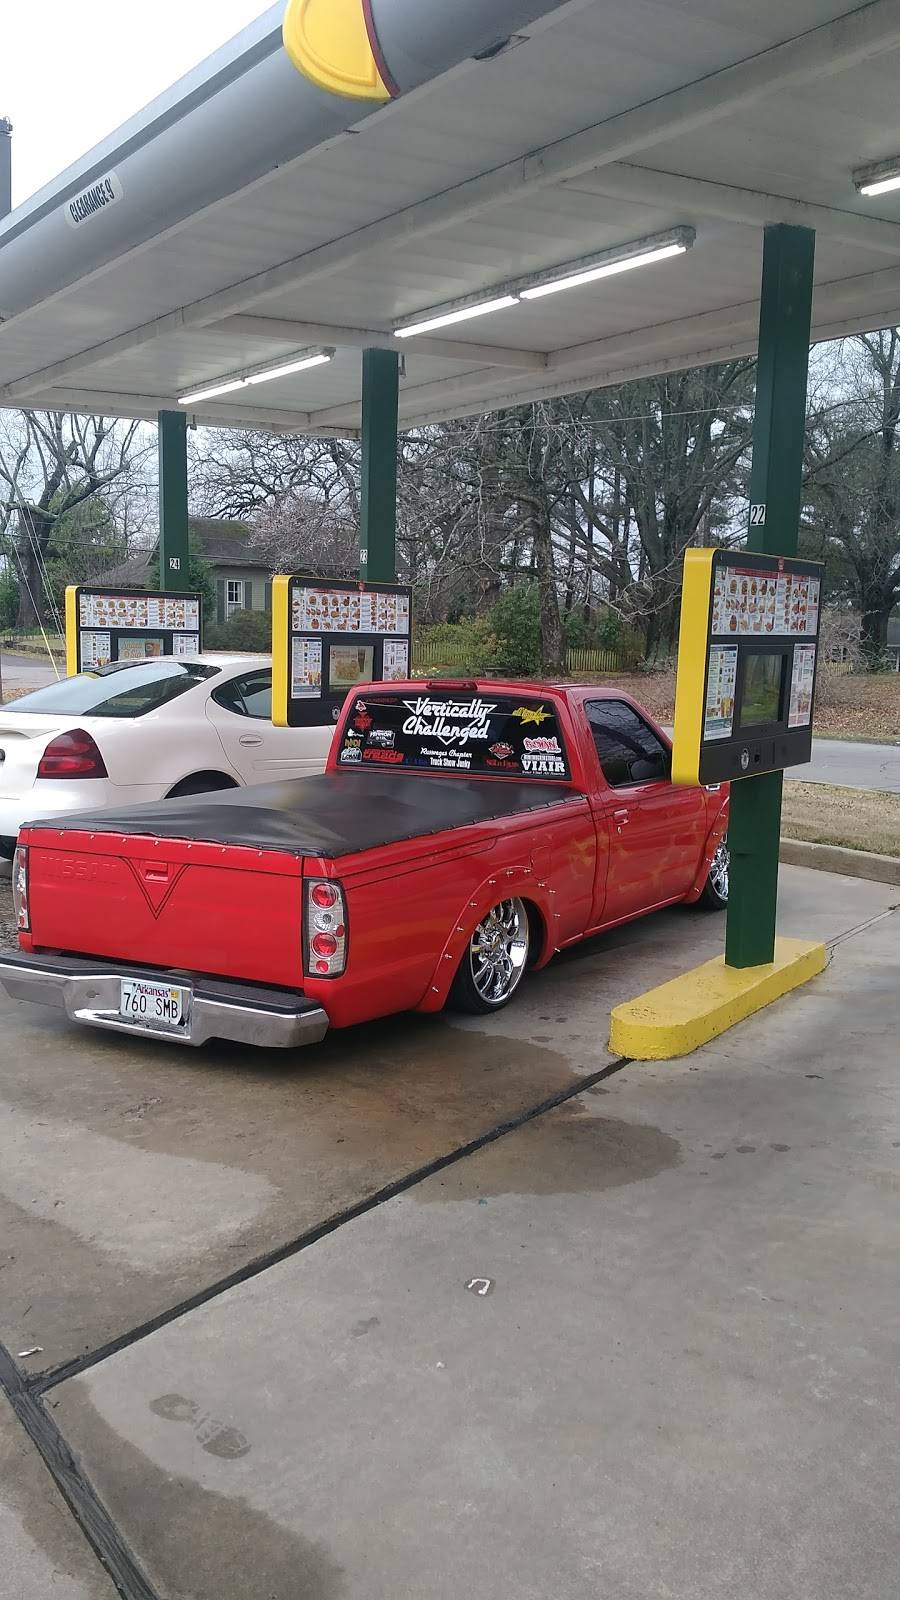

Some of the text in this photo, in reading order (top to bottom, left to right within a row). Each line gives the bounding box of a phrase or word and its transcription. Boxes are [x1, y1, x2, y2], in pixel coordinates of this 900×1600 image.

[69, 177, 115, 223] CLEARANCE 9'
[750, 505, 765, 525] 22
[170, 558, 180, 569] 24
[415, 697, 489, 727] Vertically
[402, 715, 491, 746] Challenged
[430, 757, 443, 767] Truck
[443, 758, 456, 767] Show
[456, 758, 471, 769] Junky
[448, 749, 473, 760] Chapter
[521, 760, 566, 773] VIAIR
[135, 983, 169, 998] Arkansas
[123, 992, 147, 1013] 760
[155, 997, 178, 1019] SMB
